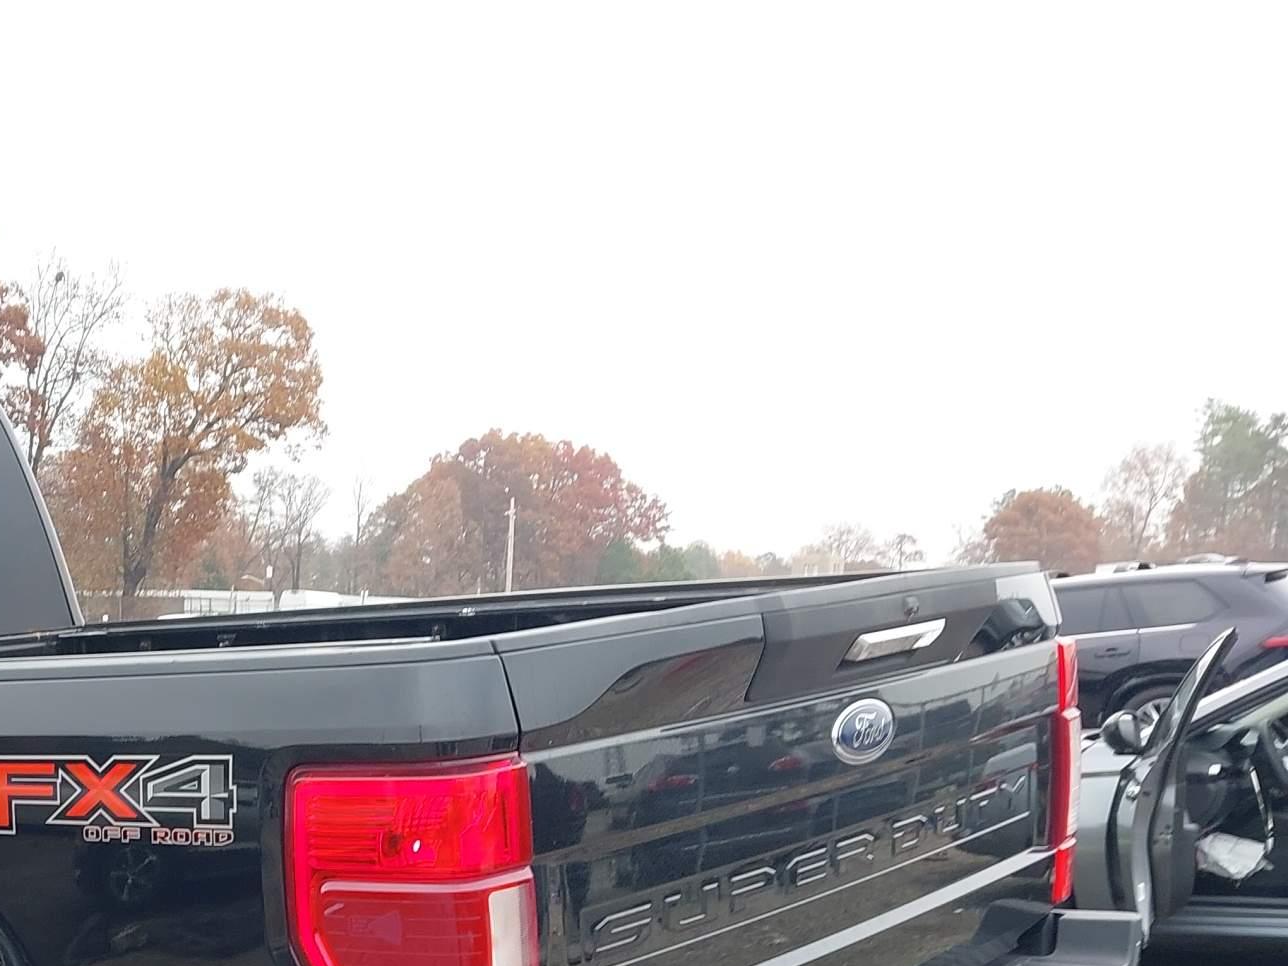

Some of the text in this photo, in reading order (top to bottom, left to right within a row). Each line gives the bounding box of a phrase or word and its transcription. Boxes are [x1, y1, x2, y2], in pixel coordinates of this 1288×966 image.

[852, 711, 887, 749] Ford
[82, 825, 235, 847] OFF ROAD
[586, 774, 1028, 956] SUPER DUTY
